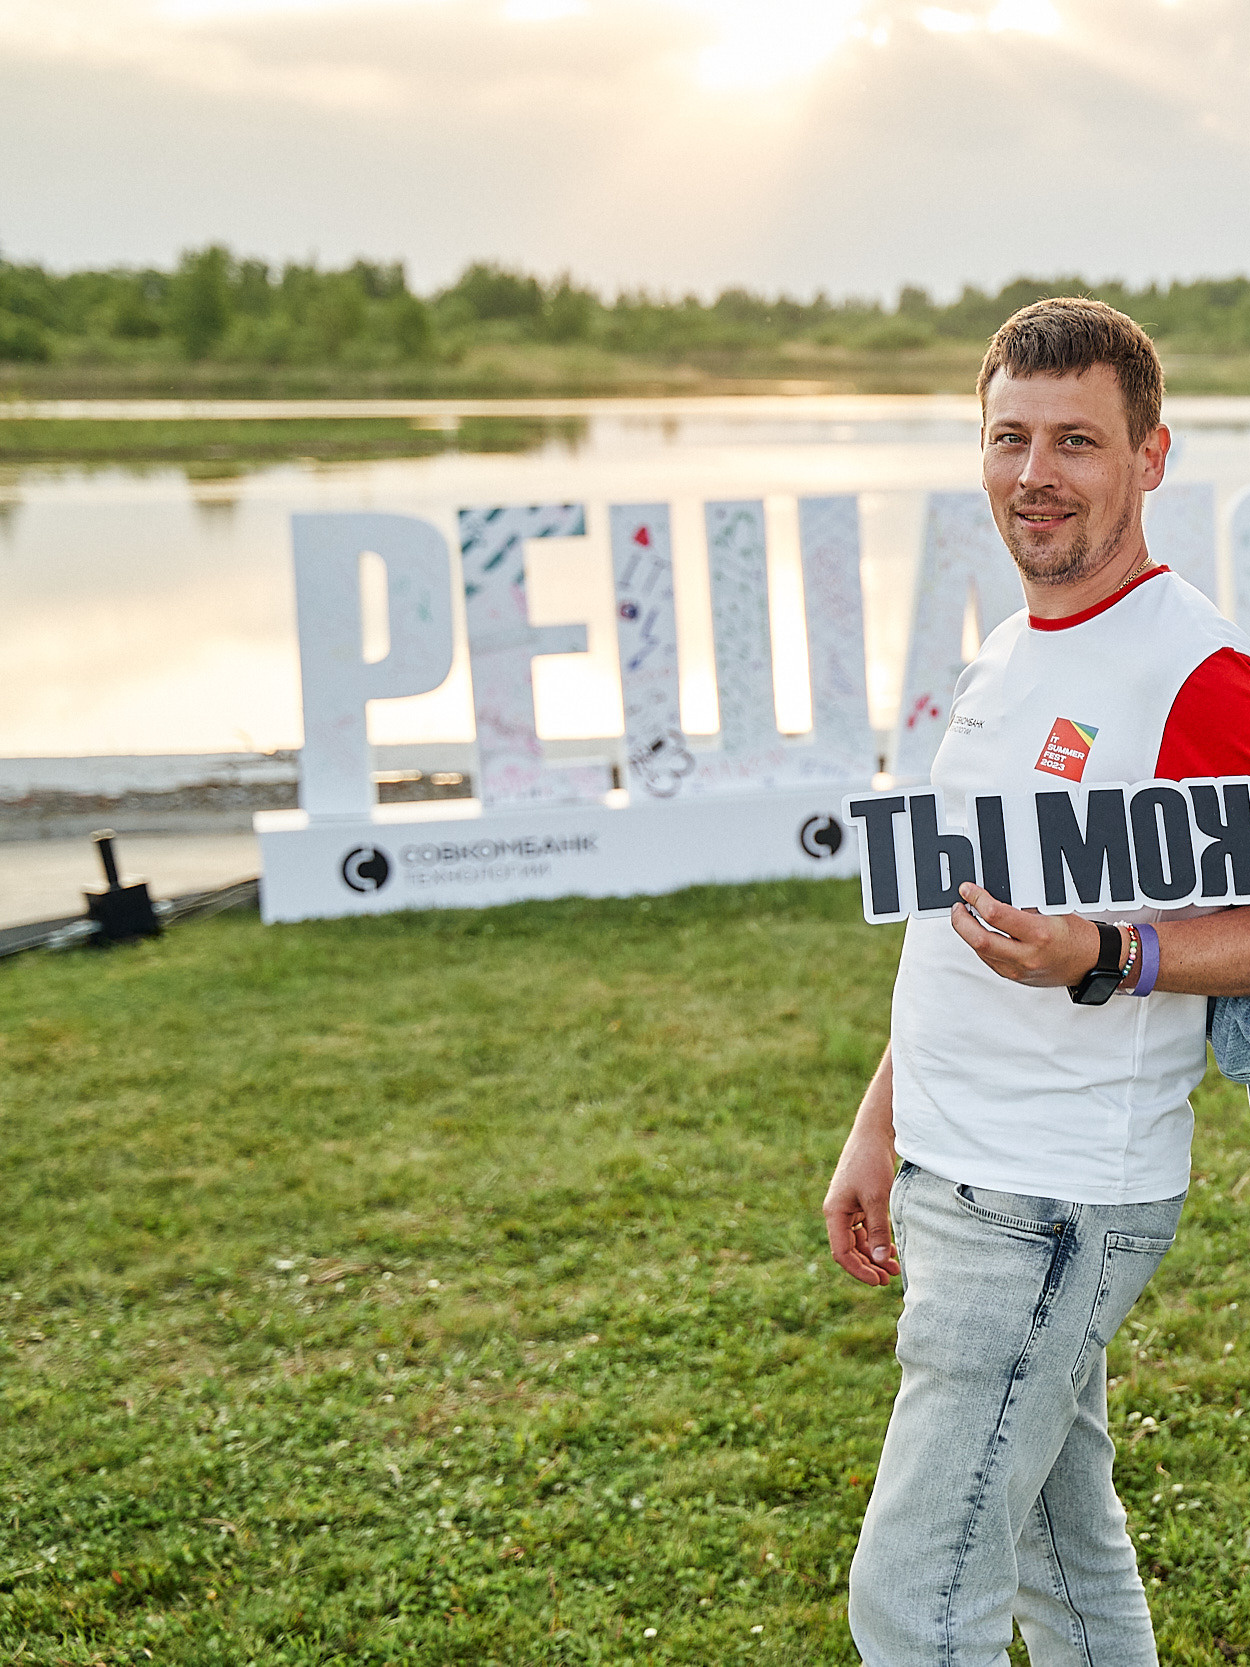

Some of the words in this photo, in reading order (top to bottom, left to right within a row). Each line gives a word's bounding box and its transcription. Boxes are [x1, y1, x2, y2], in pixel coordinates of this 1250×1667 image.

[1043, 751, 1067, 763] FEST
[1047, 743, 1086, 760] SUMMER
[1040, 758, 1066, 771] 2023
[850, 793, 1012, 915] ТЫ
